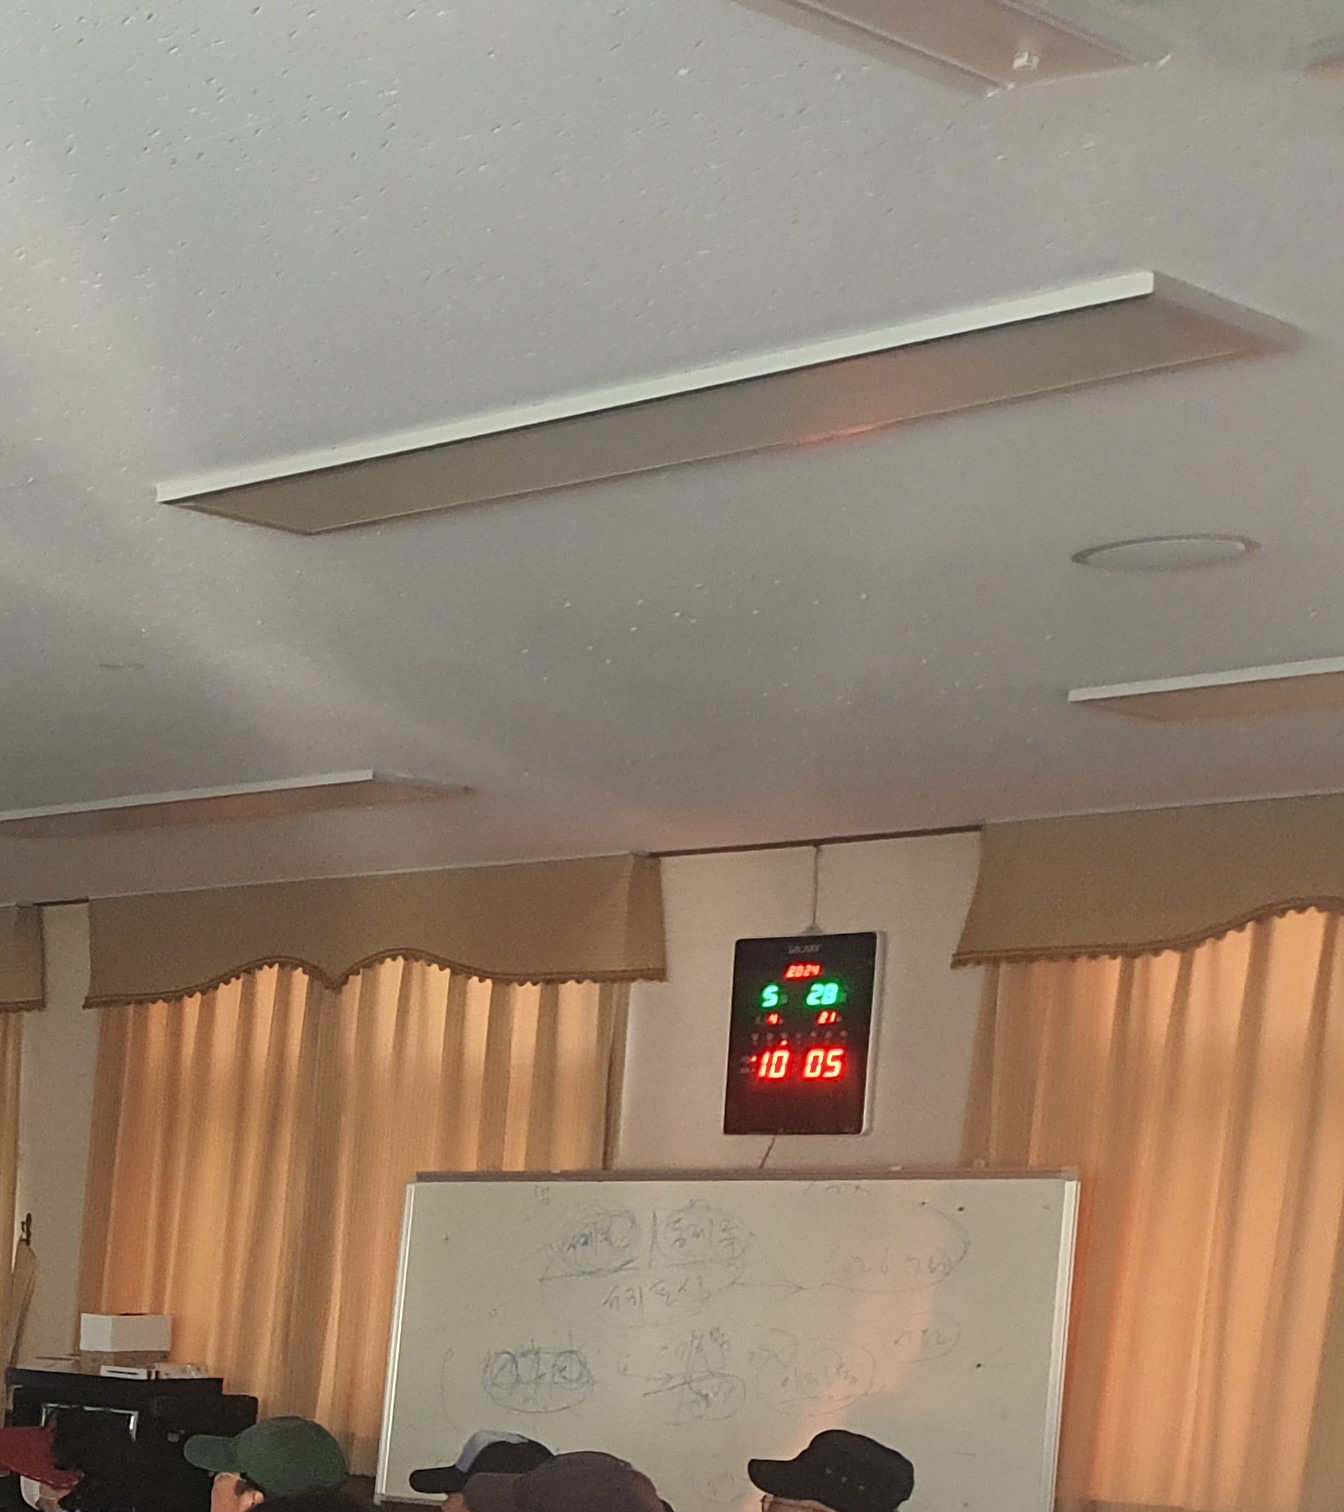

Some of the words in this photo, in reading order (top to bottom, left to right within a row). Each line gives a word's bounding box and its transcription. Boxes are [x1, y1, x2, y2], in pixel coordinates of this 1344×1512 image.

[786, 964, 820, 978] 2024
[761, 984, 779, 1008] 5
[806, 982, 839, 1006] 28
[816, 1011, 837, 1025] 21
[758, 1050, 790, 1079] 10
[804, 1049, 844, 1078] 05
